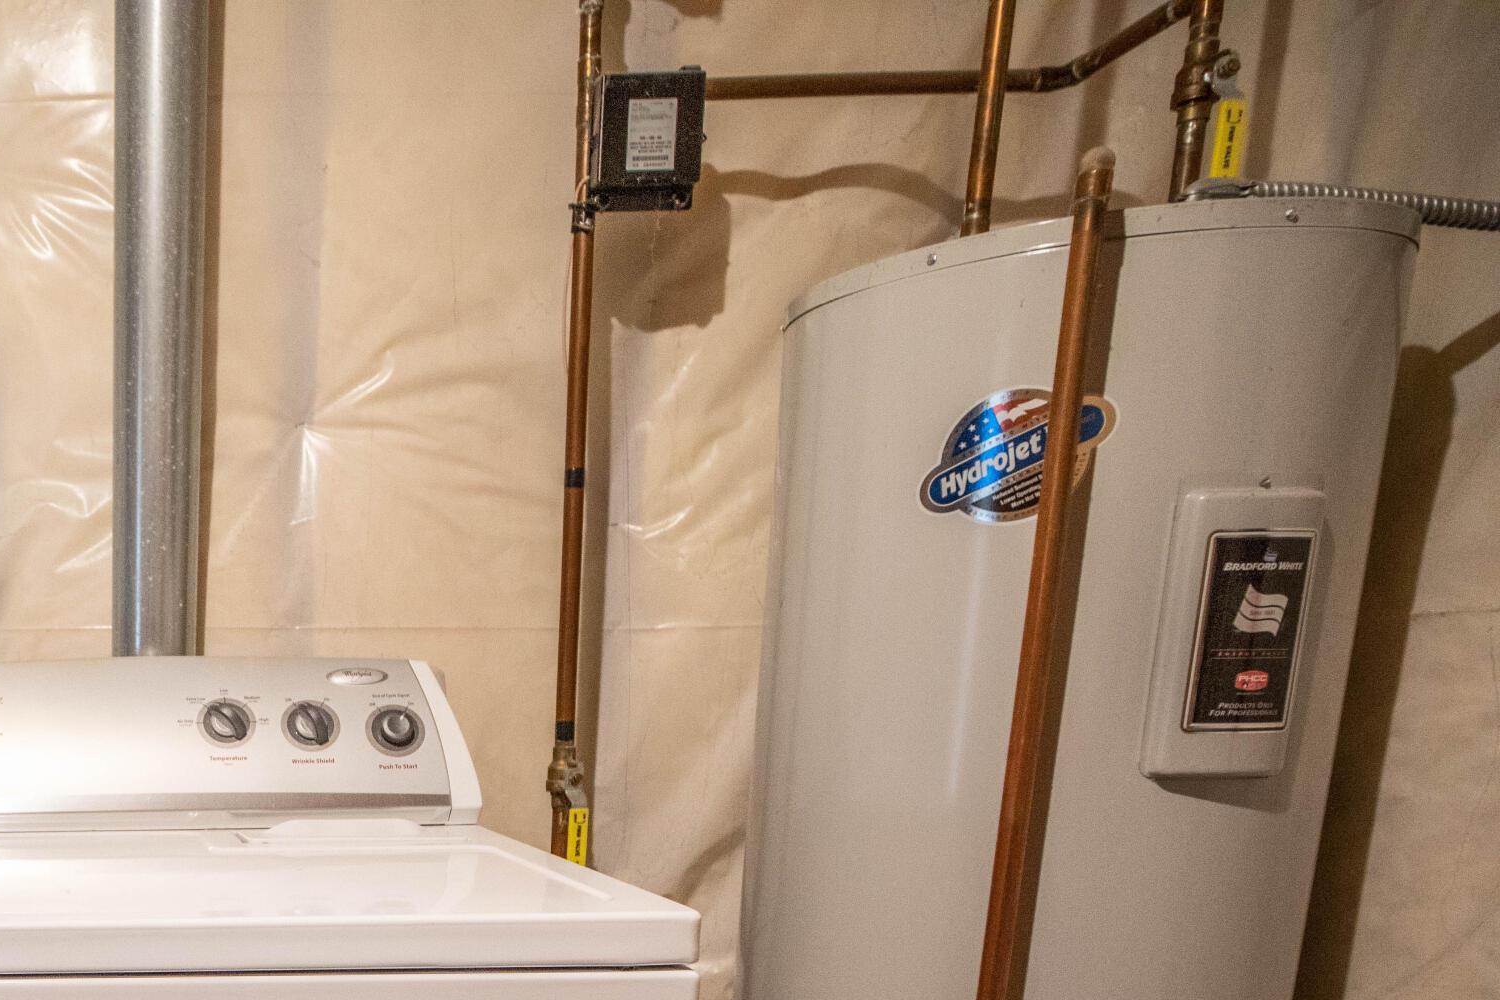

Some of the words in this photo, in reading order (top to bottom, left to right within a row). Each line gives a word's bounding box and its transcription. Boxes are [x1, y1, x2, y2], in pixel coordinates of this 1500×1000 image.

[940, 432, 1042, 499] Hydrojet
[1223, 561, 1277, 572] BRADFORD
[1278, 561, 1303, 571] WHITE
